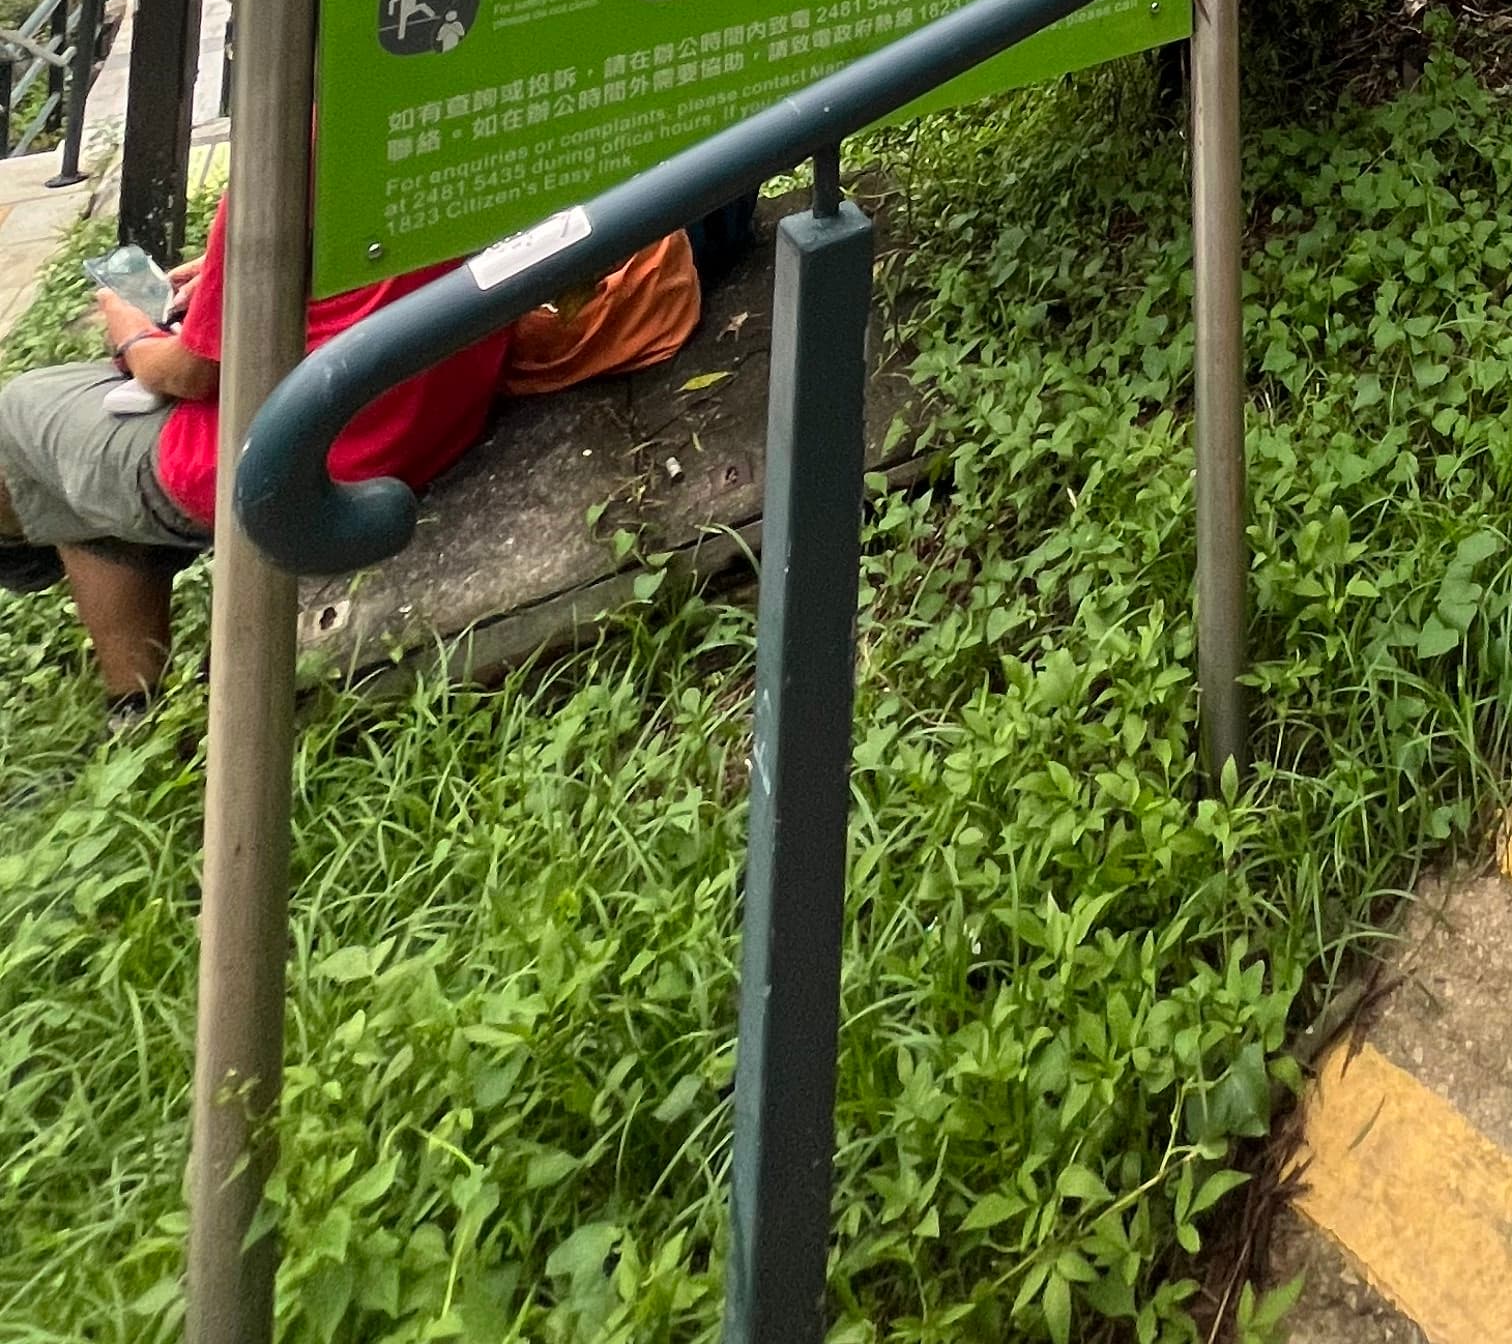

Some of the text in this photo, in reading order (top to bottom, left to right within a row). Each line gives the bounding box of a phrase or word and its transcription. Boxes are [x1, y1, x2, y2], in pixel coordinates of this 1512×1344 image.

[385, 175, 422, 197] For
[535, 138, 553, 155] or
[413, 180, 465, 209] 2481
[474, 164, 525, 191] 5435
[532, 147, 595, 174] during
[602, 131, 653, 154] office
[387, 207, 440, 236] 1823
[544, 168, 592, 190] Easy
